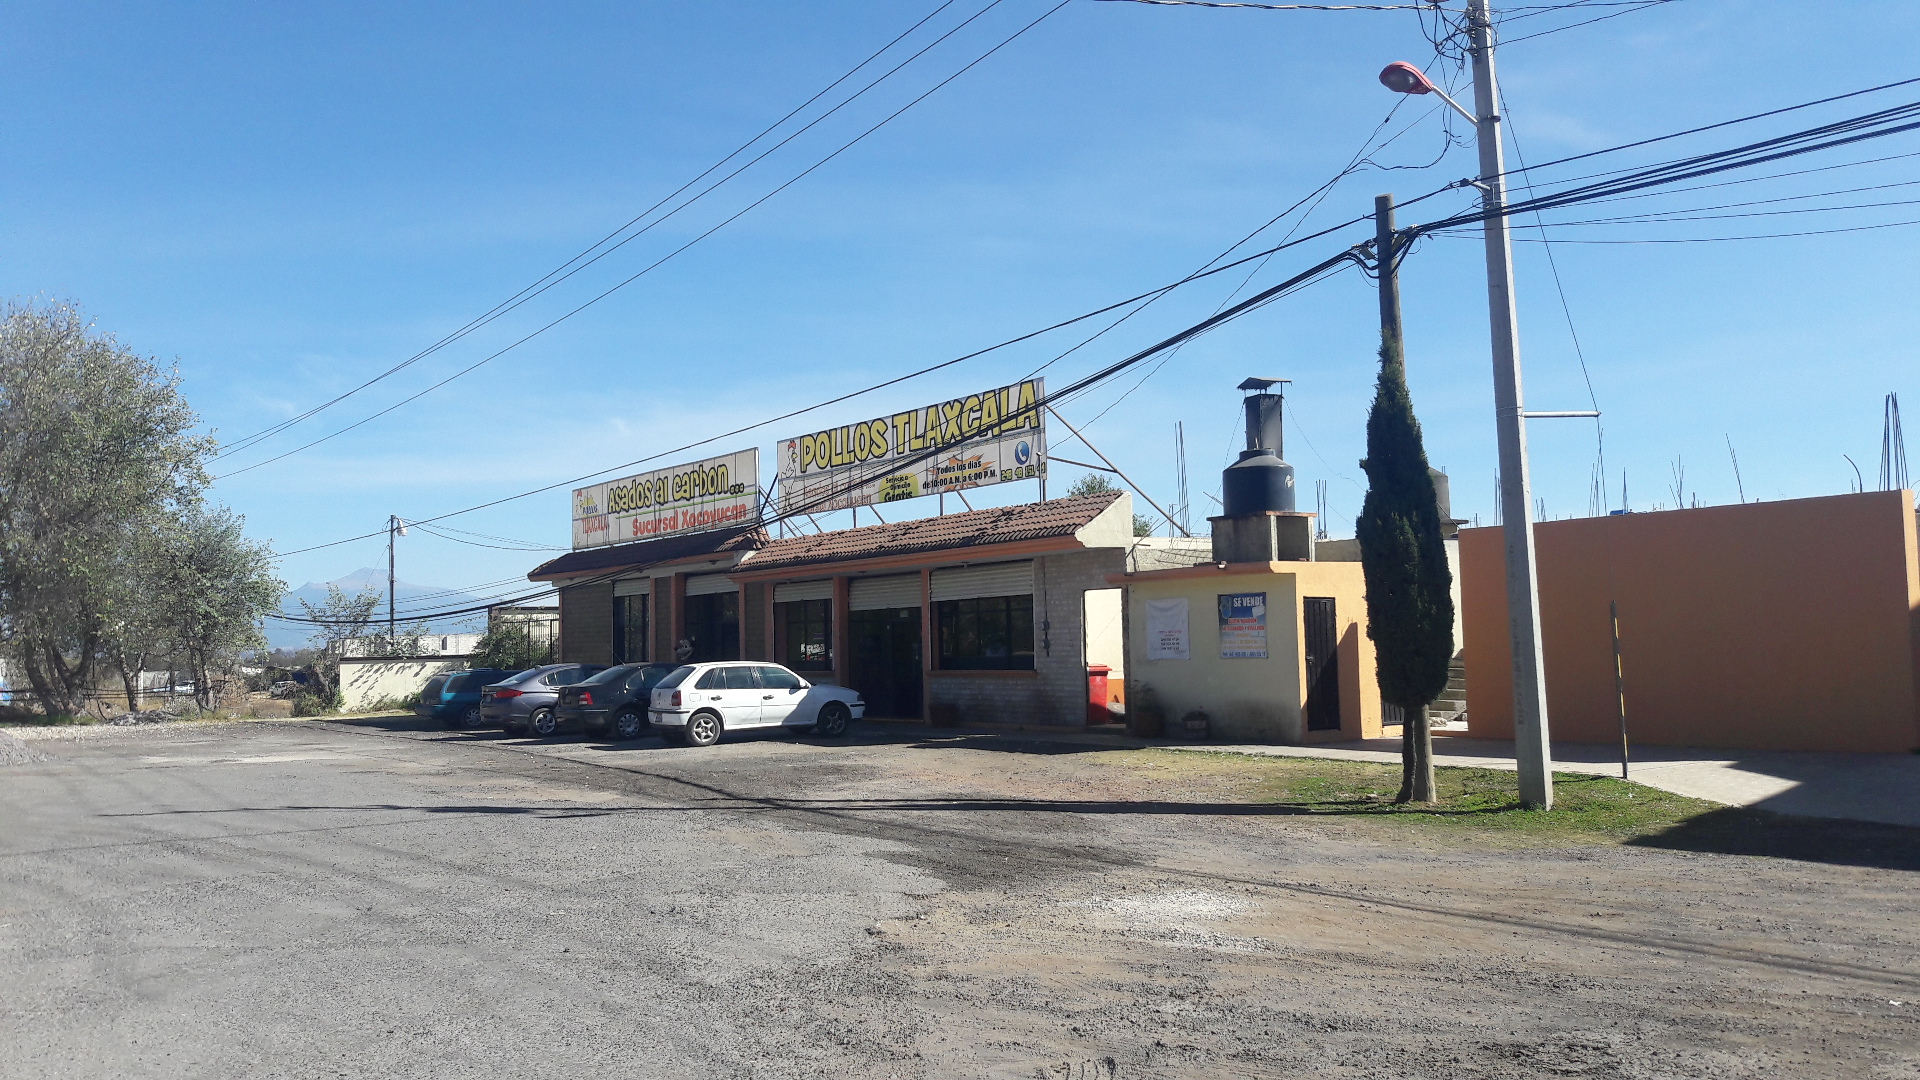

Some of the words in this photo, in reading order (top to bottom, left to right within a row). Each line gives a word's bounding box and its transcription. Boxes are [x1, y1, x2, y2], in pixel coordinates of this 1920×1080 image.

[800, 418, 888, 473] POLLOS
[892, 379, 1040, 455] TLAXCALA
[937, 465, 955, 475] Todos
[956, 462, 966, 472] los
[923, 480, 931, 489] de
[931, 477, 948, 488] 10:00
[968, 471, 983, 481] 6:00
[608, 479, 653, 514] Asados
[655, 476, 669, 506] al
[884, 489, 913, 502] Gratis
[632, 510, 679, 536] Sucursal
[682, 502, 747, 530] Xocoyucan
[1233, 597, 1242, 608] SE
[1243, 596, 1263, 607] VENDE
